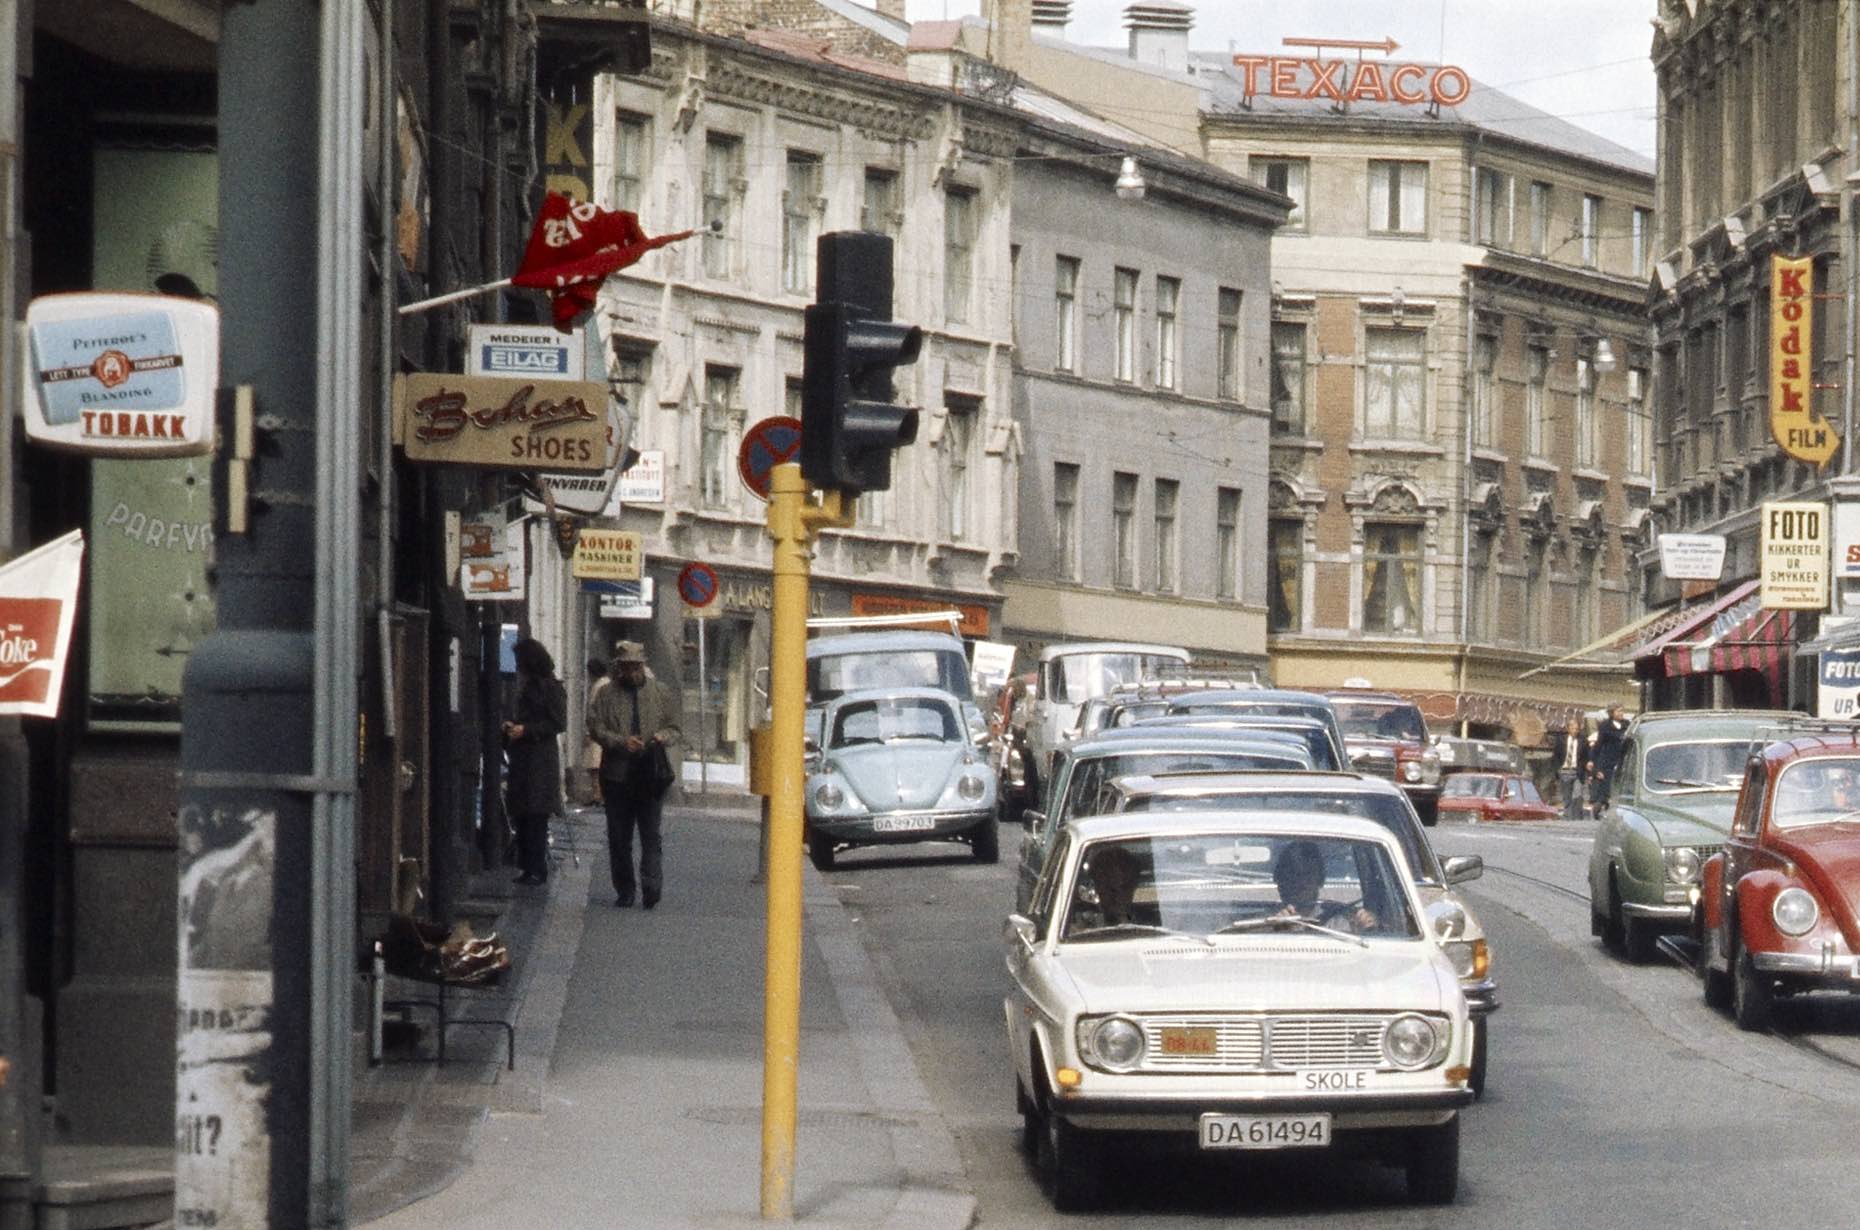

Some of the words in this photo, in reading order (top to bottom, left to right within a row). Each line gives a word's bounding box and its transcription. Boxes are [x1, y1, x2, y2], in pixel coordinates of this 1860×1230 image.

[1233, 55, 1471, 106] TEXACO
[490, 334, 551, 344] MEDEIER
[1778, 268, 1807, 412] Kodak
[491, 351, 559, 366] EILAG
[82, 411, 186, 438] TOBAKK
[1788, 428, 1826, 448] FILM
[511, 436, 591, 461] SHOES
[1770, 510, 1819, 540] FOTO
[1768, 544, 1821, 556] KIKKERTER
[1787, 558, 1800, 569] UR
[1770, 572, 1819, 582] SMYKKER
[1834, 698, 1854, 714] UR
[1306, 1072, 1366, 1089] SKOLE
[1208, 1121, 1322, 1144] DA61494
